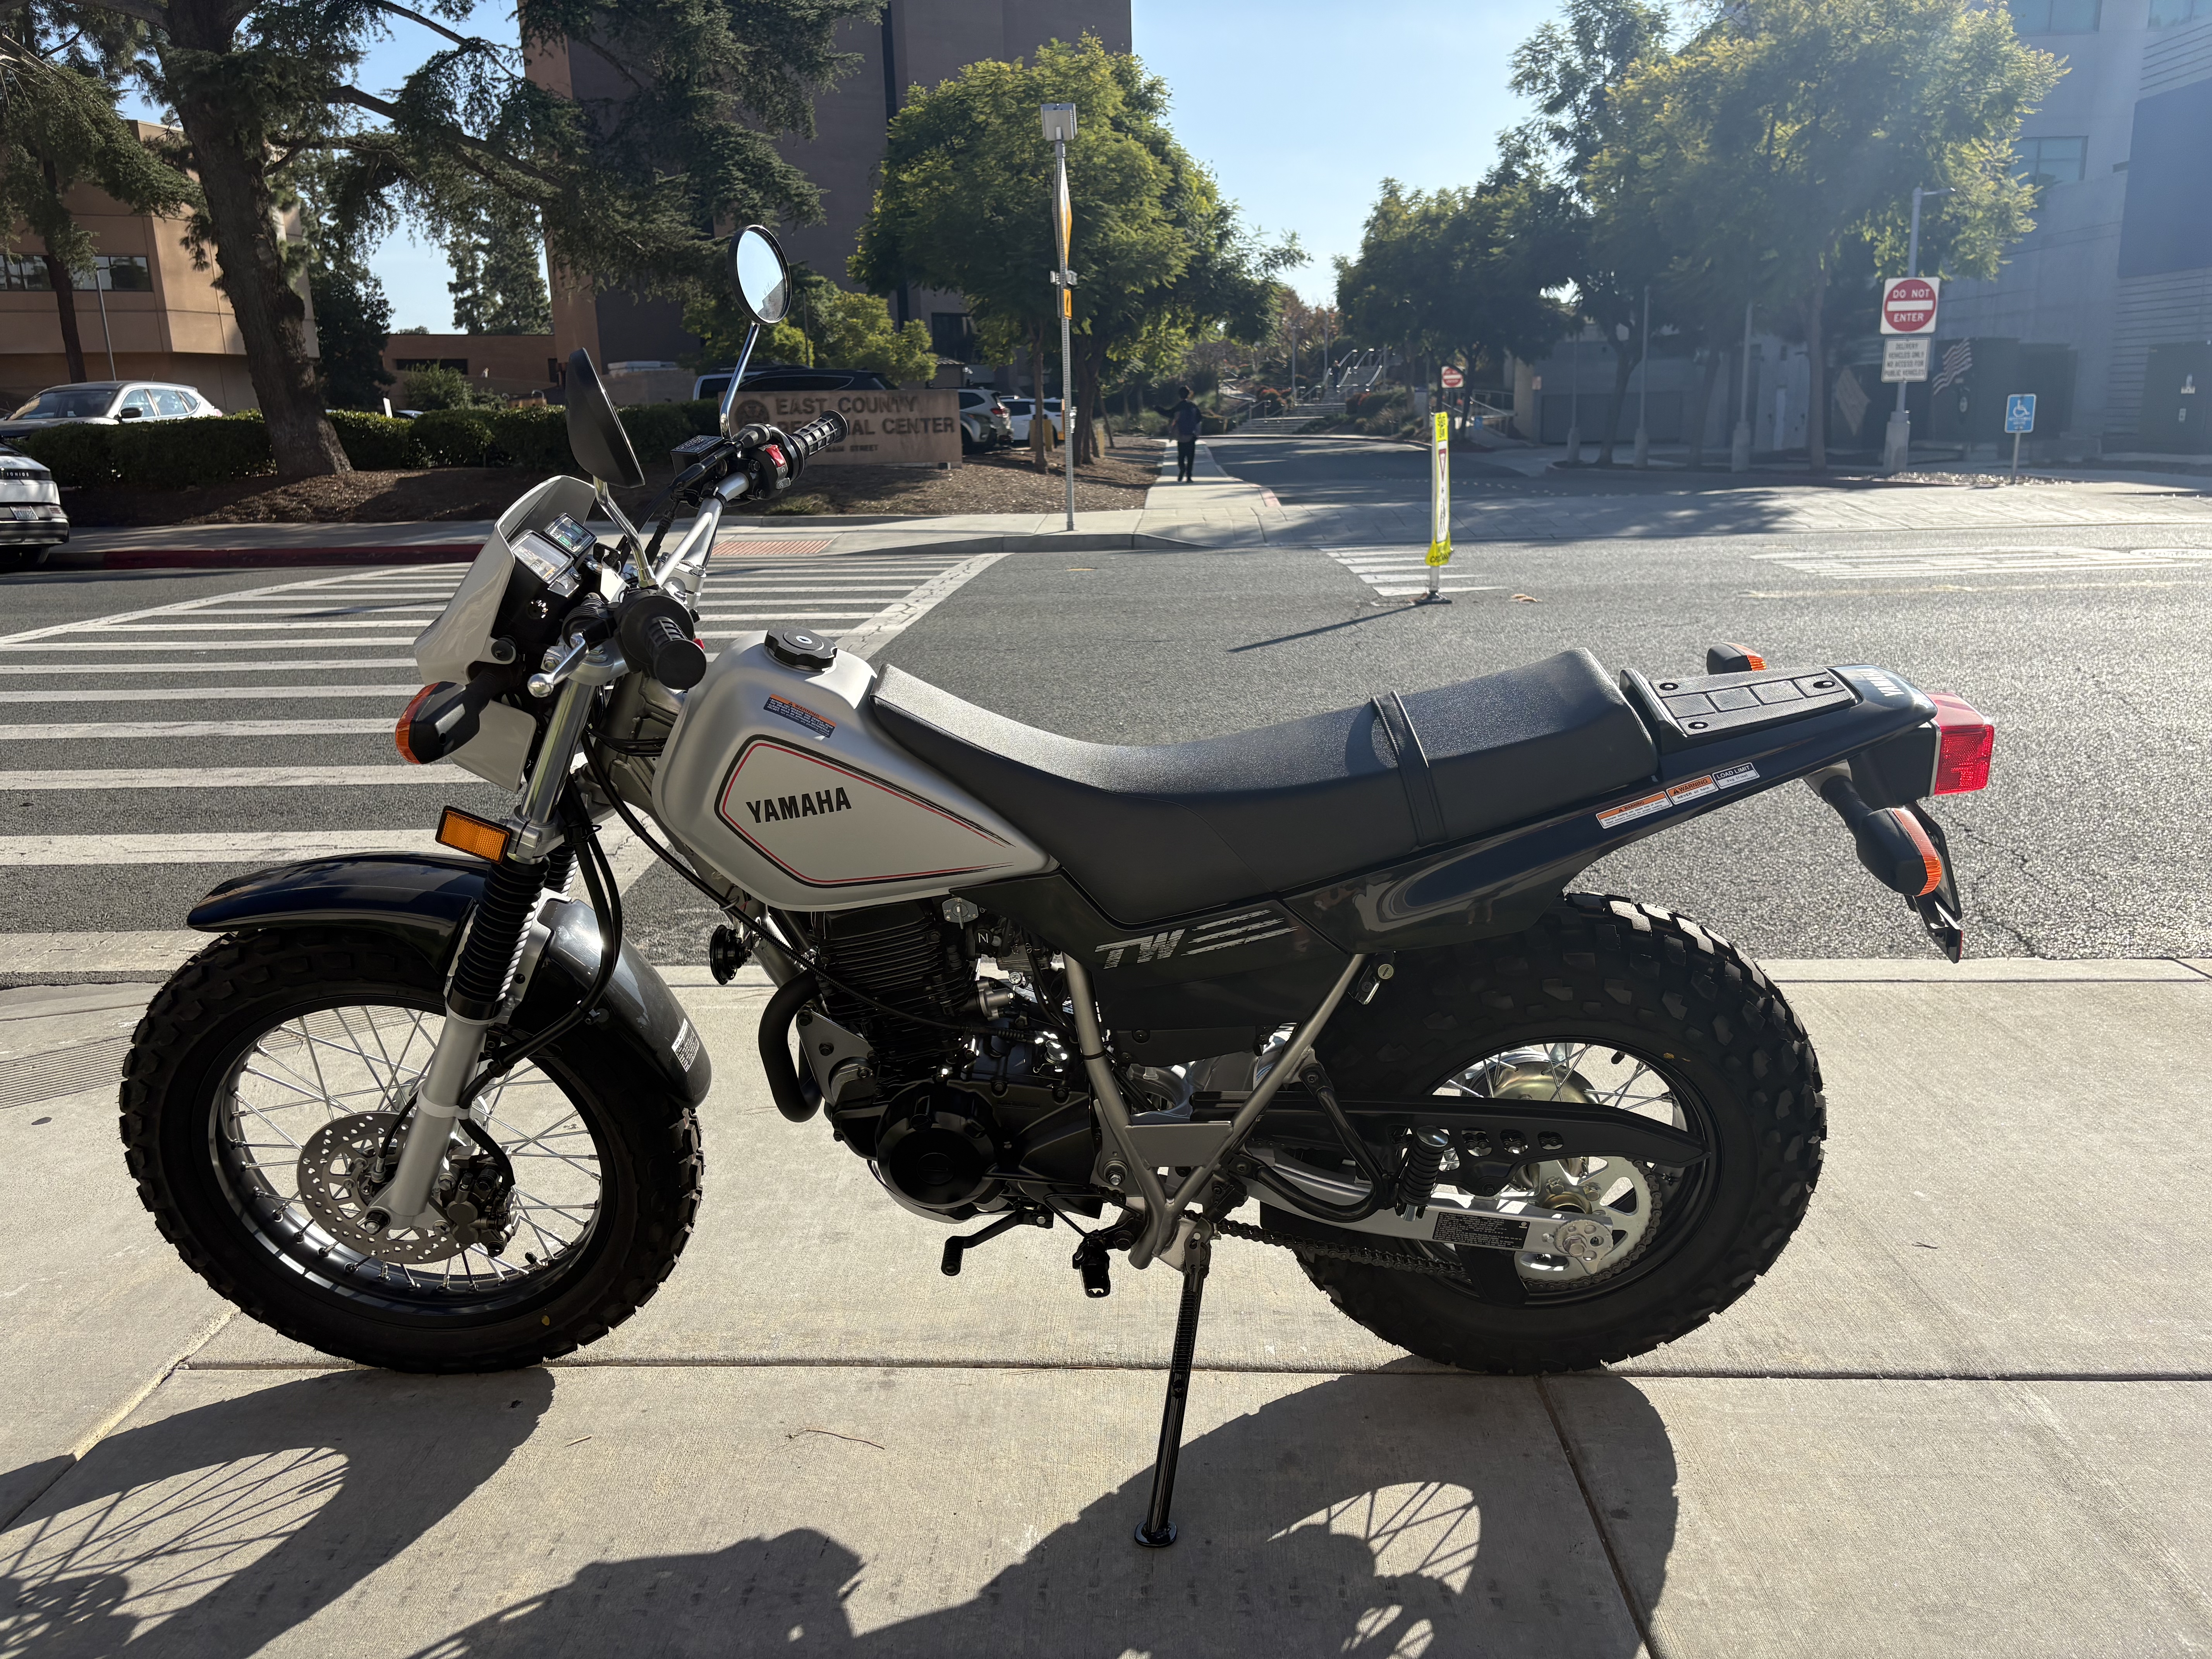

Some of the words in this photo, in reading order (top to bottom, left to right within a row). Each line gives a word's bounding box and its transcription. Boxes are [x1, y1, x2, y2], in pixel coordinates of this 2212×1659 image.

[1893, 290, 1906, 299] DO
[1911, 289, 1930, 298] NOT
[1894, 313, 1924, 322] ENTER
[776, 398, 828, 415] EAST
[838, 397, 917, 413] COUNTY
[883, 417, 955, 434] CENTER
[1856, 668, 1905, 697] YAMAHA
[794, 704, 820, 718] WARNING
[1716, 771, 1733, 779] LOAD
[1678, 779, 1708, 792] WARNING
[746, 787, 852, 823] YAMAHA
[1624, 801, 1644, 810] WARNING
